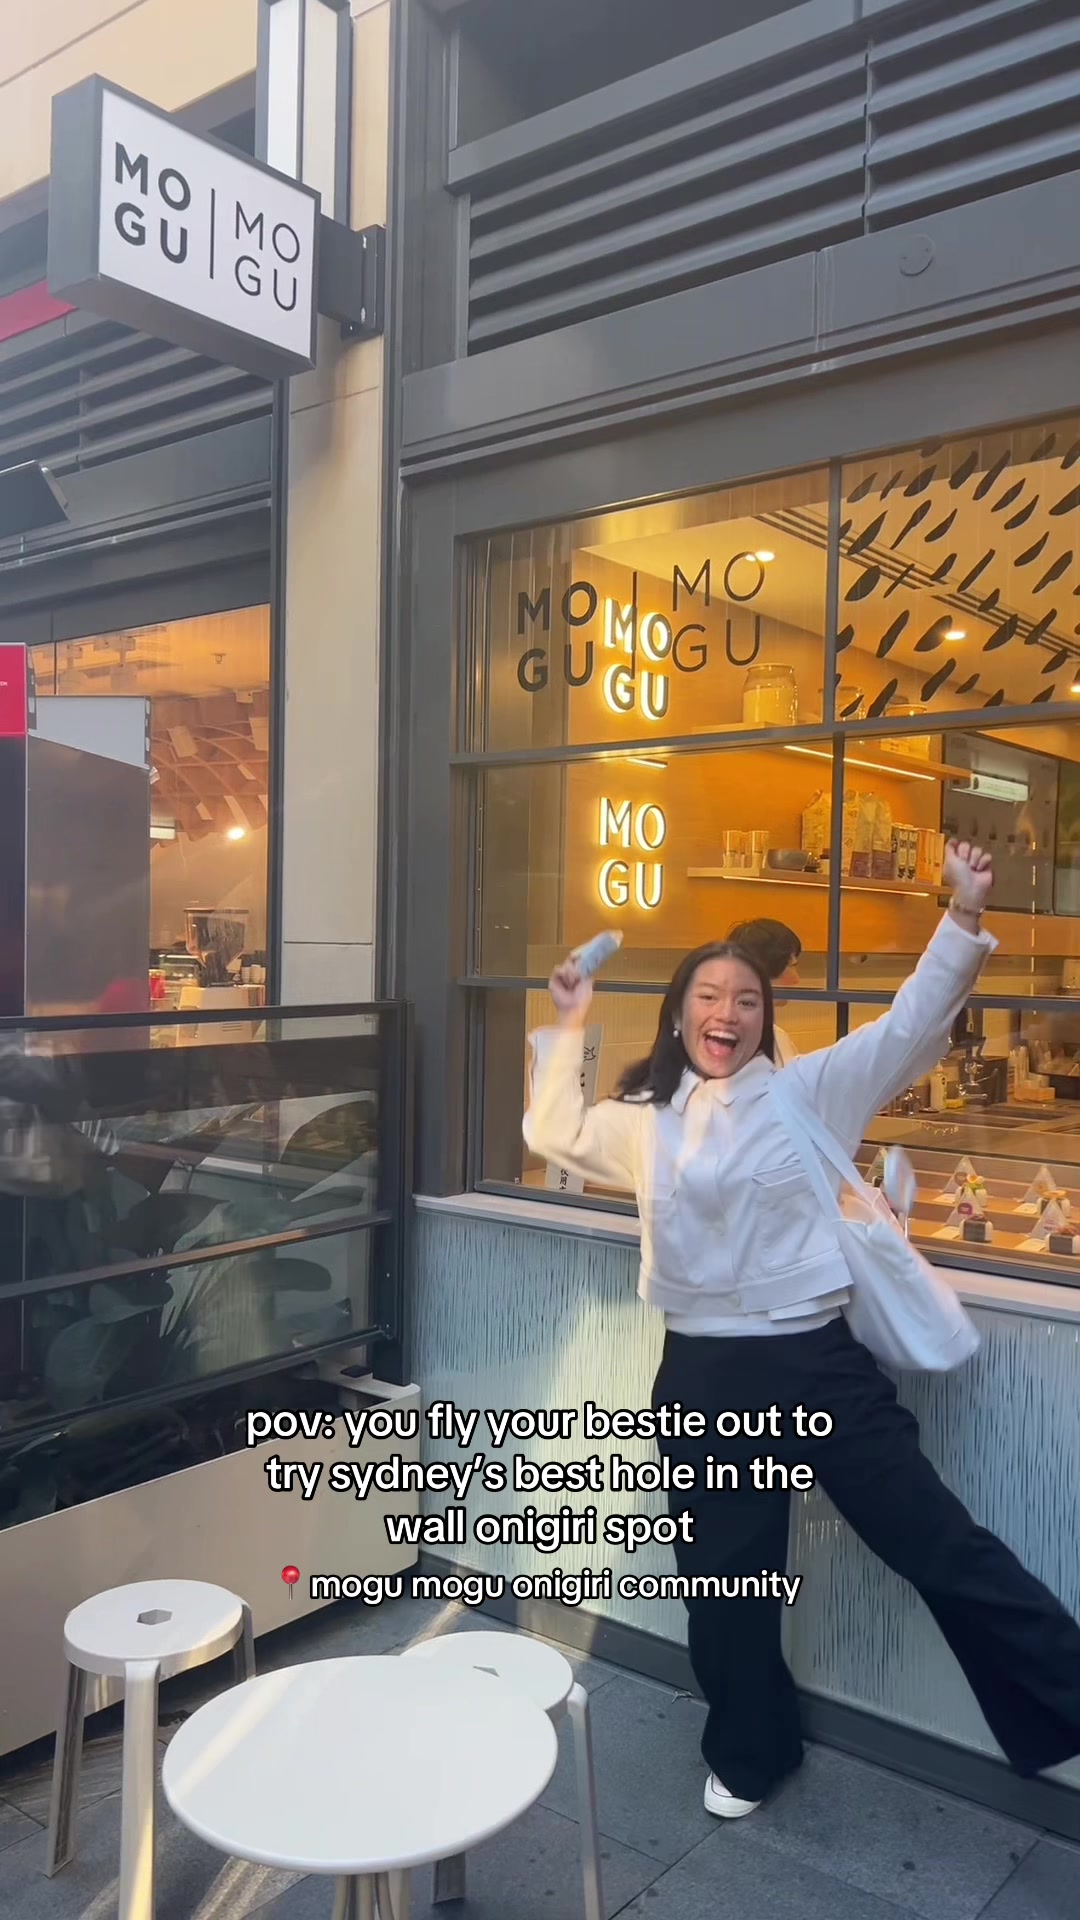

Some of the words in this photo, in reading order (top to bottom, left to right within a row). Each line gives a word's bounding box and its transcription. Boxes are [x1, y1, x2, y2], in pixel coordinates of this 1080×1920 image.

[114, 140, 192, 212] MO
[234, 200, 301, 264] MO
[114, 202, 188, 264] GU
[234, 255, 298, 312] GU
[516, 580, 598, 635] MO
[672, 551, 766, 612] MO
[516, 640, 594, 693] GU
[671, 615, 761, 673] GU
[603, 598, 672, 661] MO
[602, 664, 669, 721] GU
[599, 796, 667, 852] MO
[598, 858, 664, 911] GU
